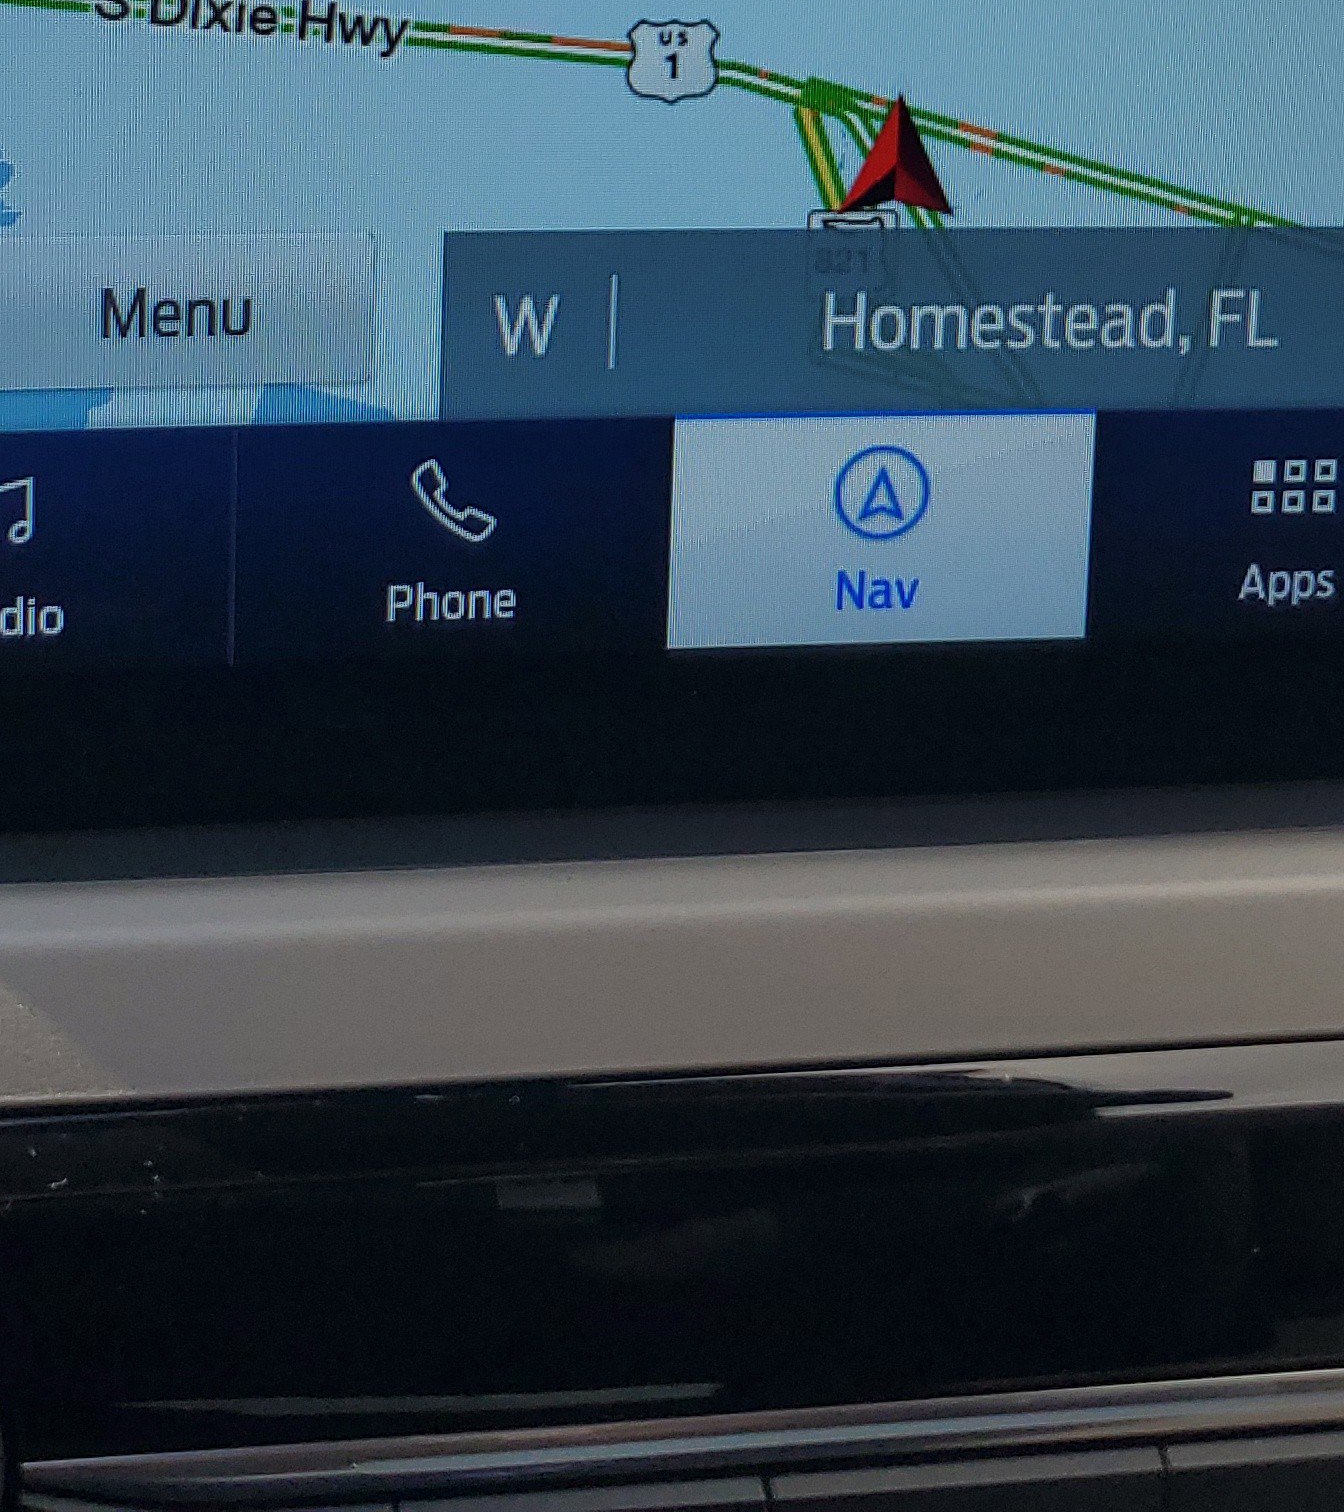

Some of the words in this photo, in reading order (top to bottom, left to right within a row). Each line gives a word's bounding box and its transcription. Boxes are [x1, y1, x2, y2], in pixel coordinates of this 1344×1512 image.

[298, 0, 409, 57] Hwy
[659, 29, 688, 46] US
[665, 52, 677, 79] 1
[100, 286, 253, 340] Menu
[492, 291, 560, 357] W
[823, 288, 1194, 356] Homestead,
[1209, 287, 1279, 349] FL
[385, 580, 517, 624] Phone
[835, 568, 920, 612] Nav
[1238, 562, 1335, 606] Apps
